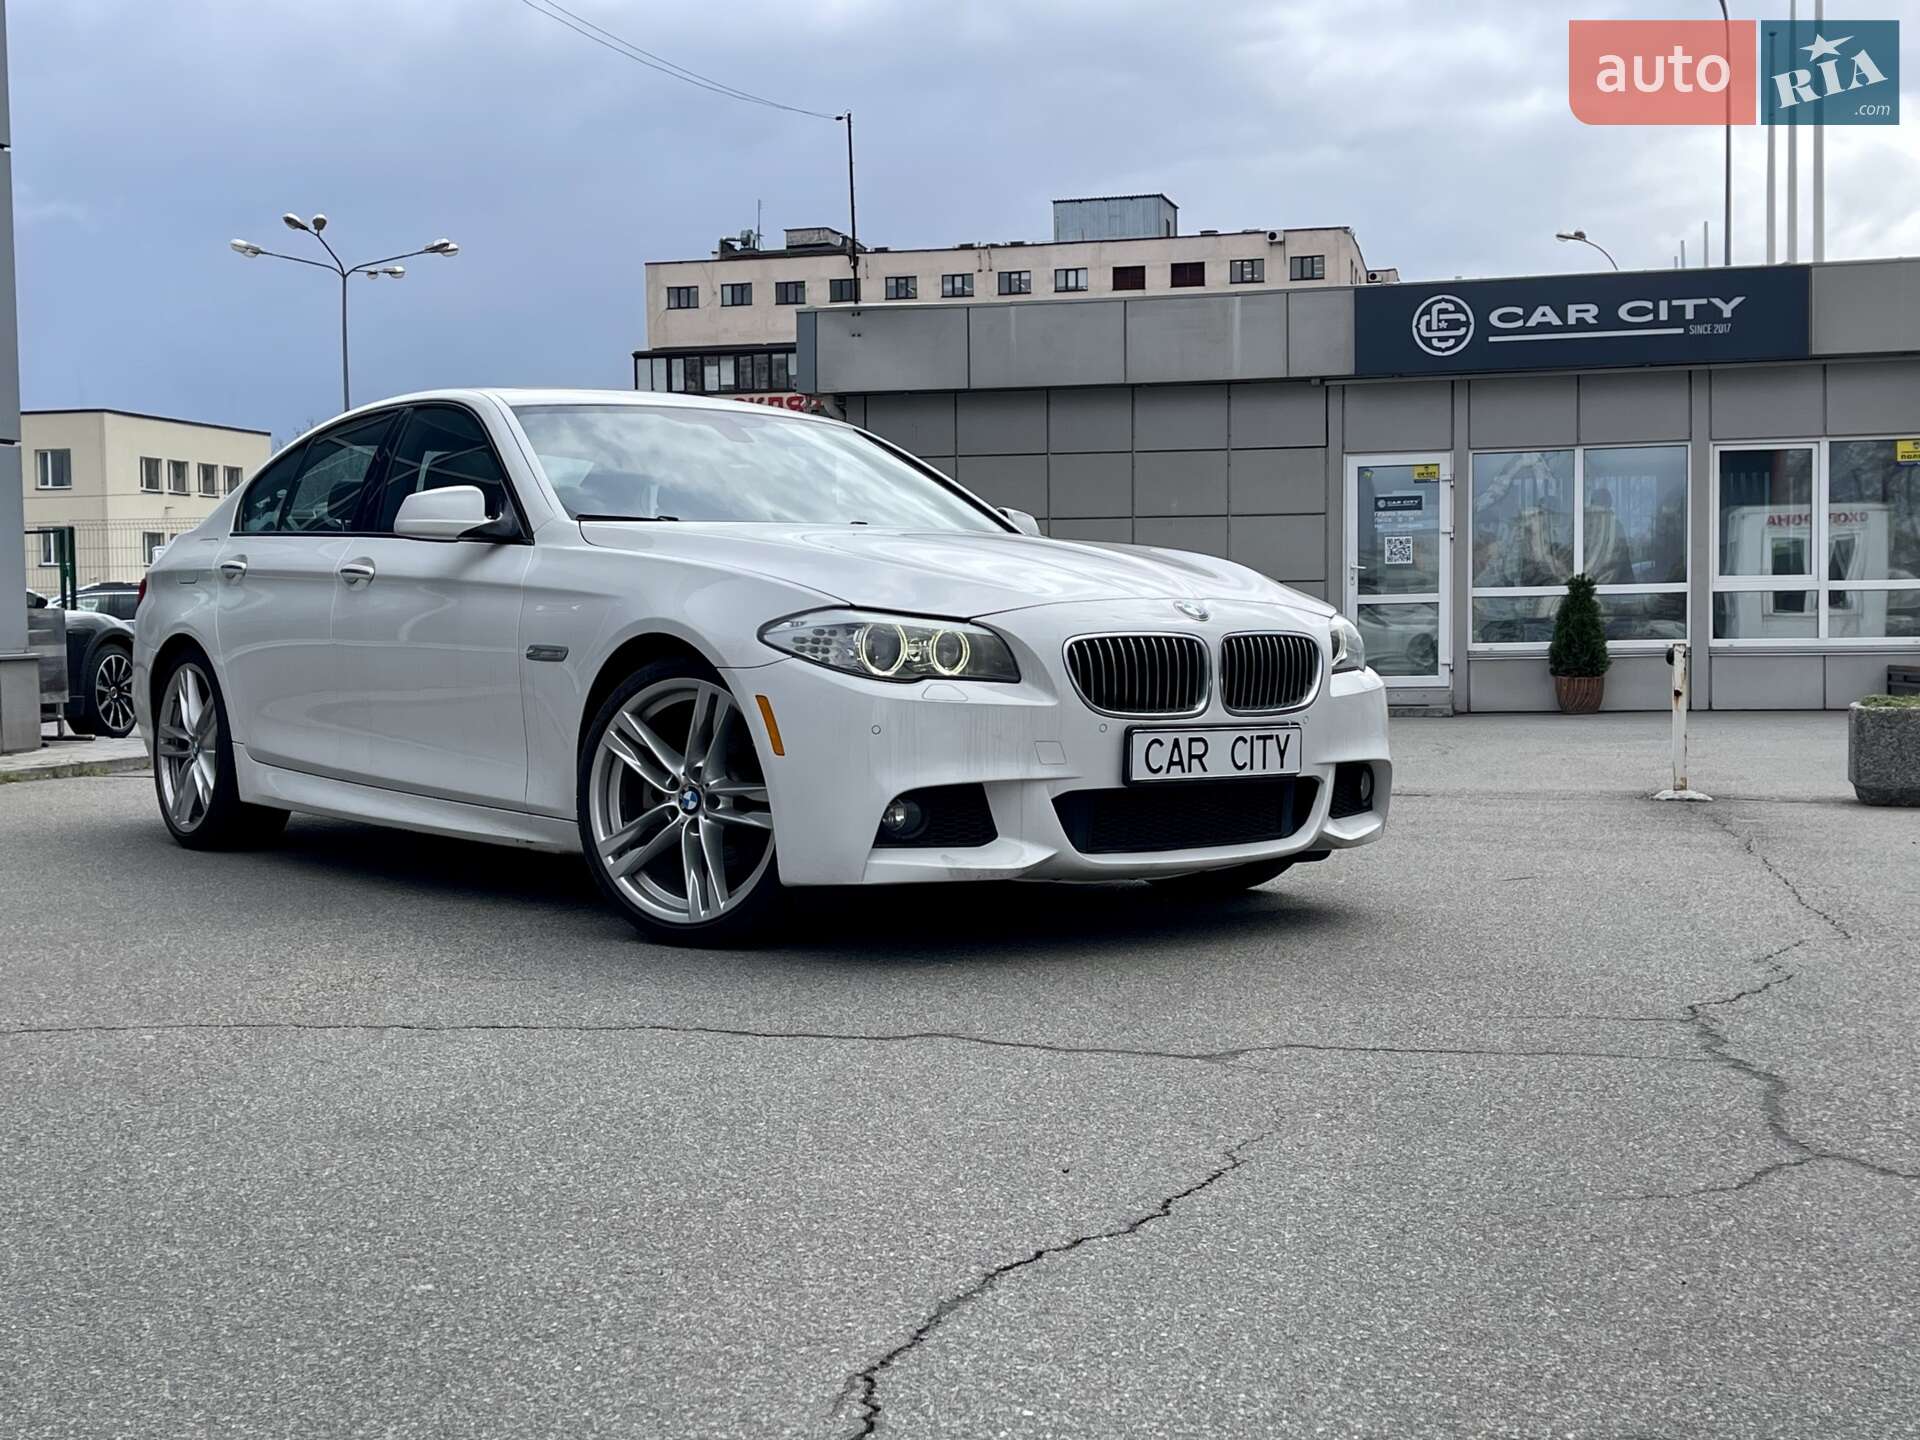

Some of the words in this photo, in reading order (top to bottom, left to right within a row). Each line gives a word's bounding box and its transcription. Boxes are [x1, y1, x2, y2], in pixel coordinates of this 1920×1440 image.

[1488, 302, 1600, 329] CAR
[1617, 296, 1746, 323] CITY
[1689, 323, 1712, 336] SINCE
[1713, 322, 1732, 334] 2017
[1144, 737, 1209, 774] CAR
[1231, 734, 1291, 771] CITY
